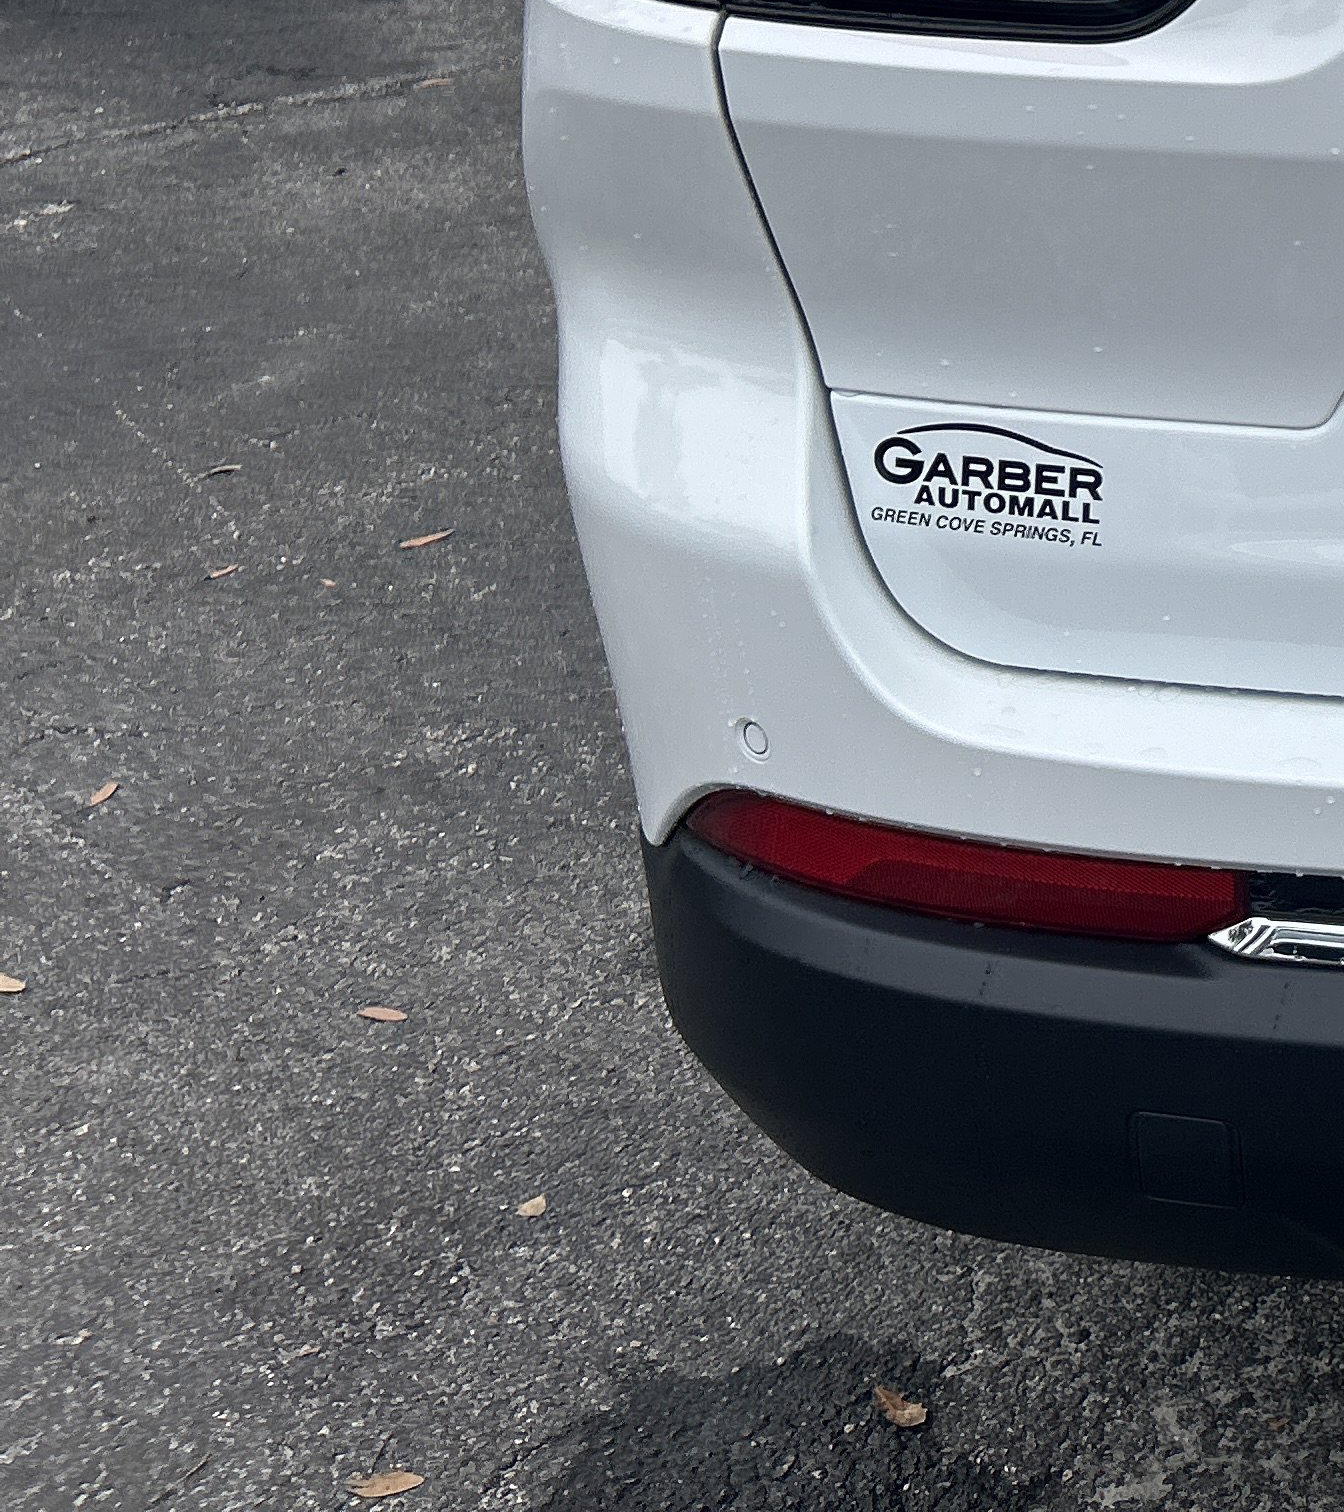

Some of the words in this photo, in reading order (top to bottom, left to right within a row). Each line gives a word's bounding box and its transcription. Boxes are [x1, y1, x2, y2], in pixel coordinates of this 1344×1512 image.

[873, 436, 1104, 501] GARBER
[914, 484, 1101, 524] AUTOMALL
[871, 506, 932, 527] GREEN
[936, 514, 986, 534] COVE
[989, 521, 1076, 547] SPRINGS,
[1080, 530, 1103, 547] FL
